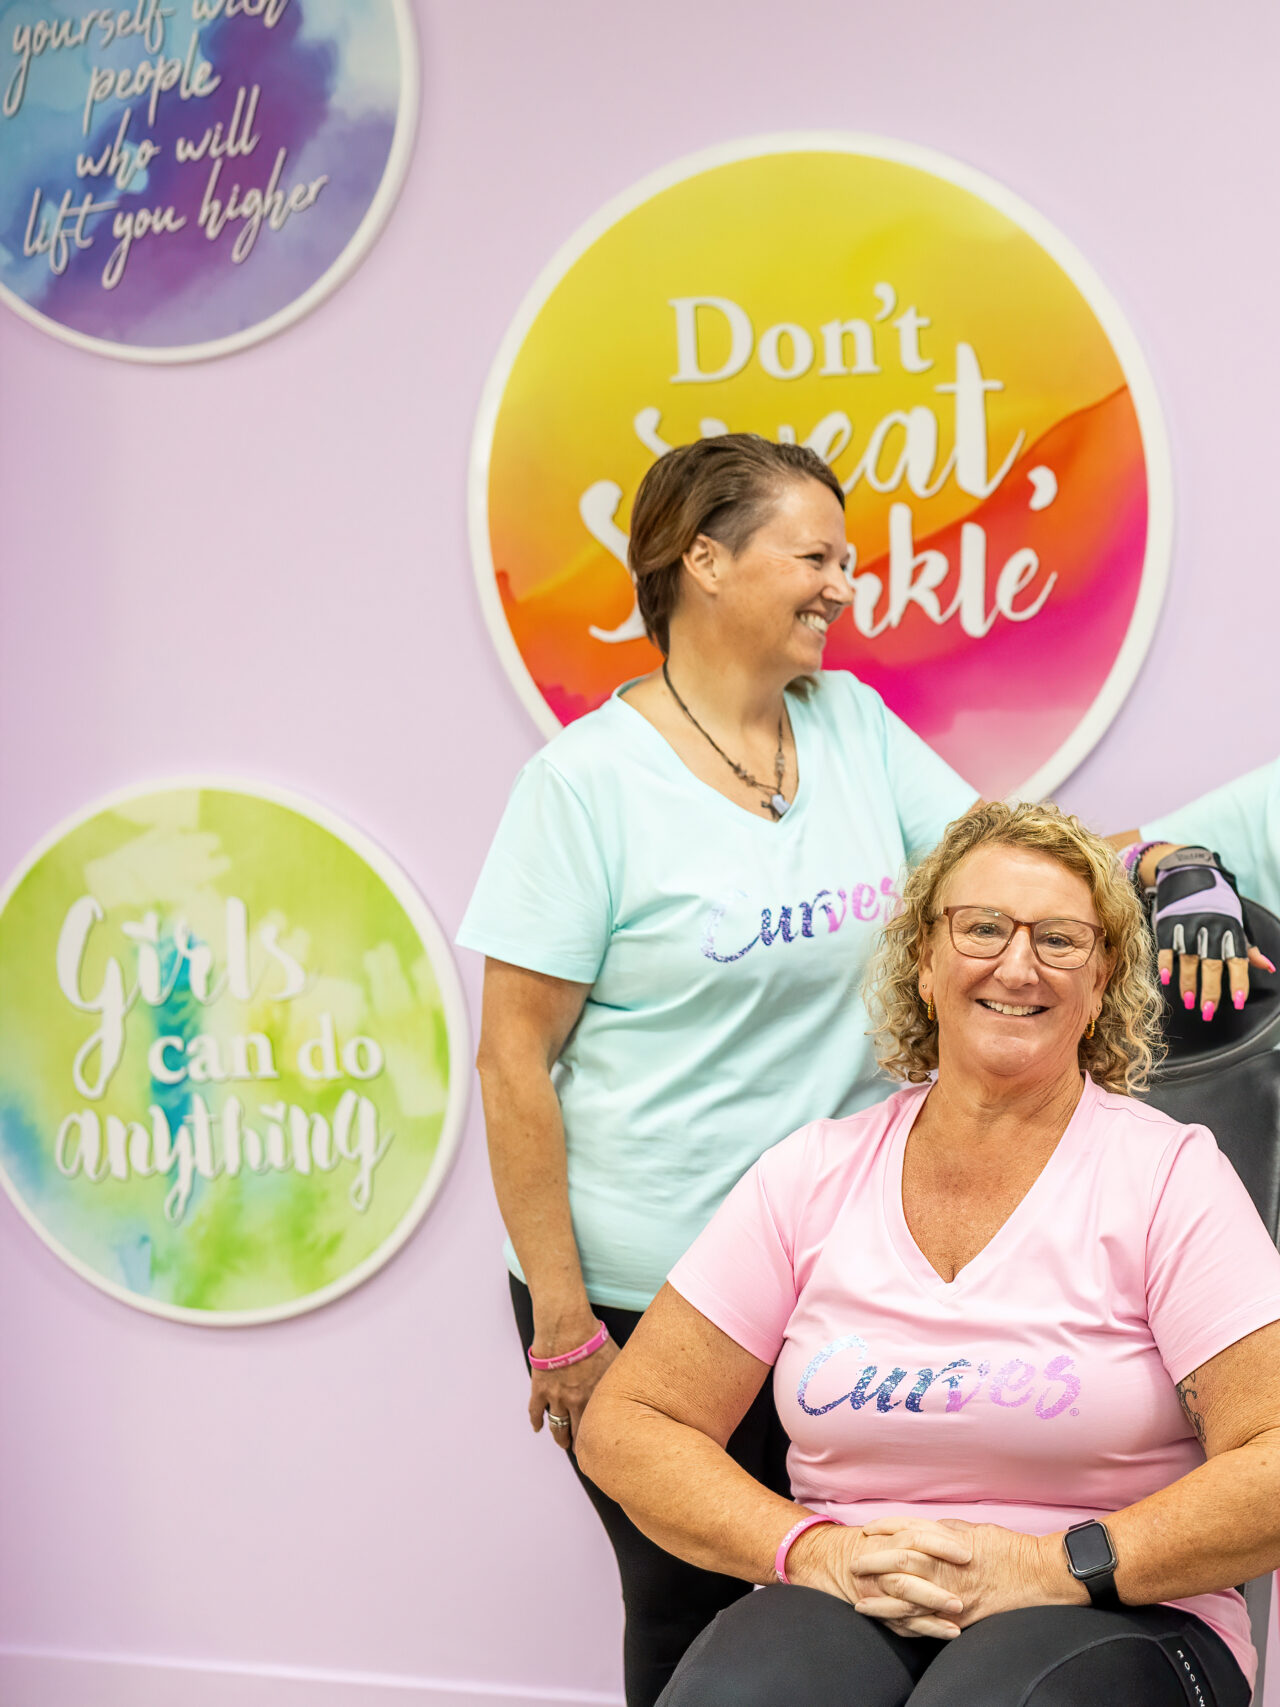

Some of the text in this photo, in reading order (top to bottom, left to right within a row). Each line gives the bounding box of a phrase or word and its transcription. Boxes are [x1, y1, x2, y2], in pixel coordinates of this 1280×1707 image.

[2, 0, 288, 117] yourself wi
[83, 30, 221, 136] people
[77, 84, 261, 190] who will
[23, 148, 329, 290] lift you higher
[668, 281, 935, 385] Don't
[633, 341, 1057, 511] eat,
[579, 479, 1057, 642] Srkle
[57, 894, 314, 1099] Girls
[148, 1013, 385, 1084] can do
[55, 1090, 395, 1226] anything
[797, 1334, 1082, 1420] Curves
